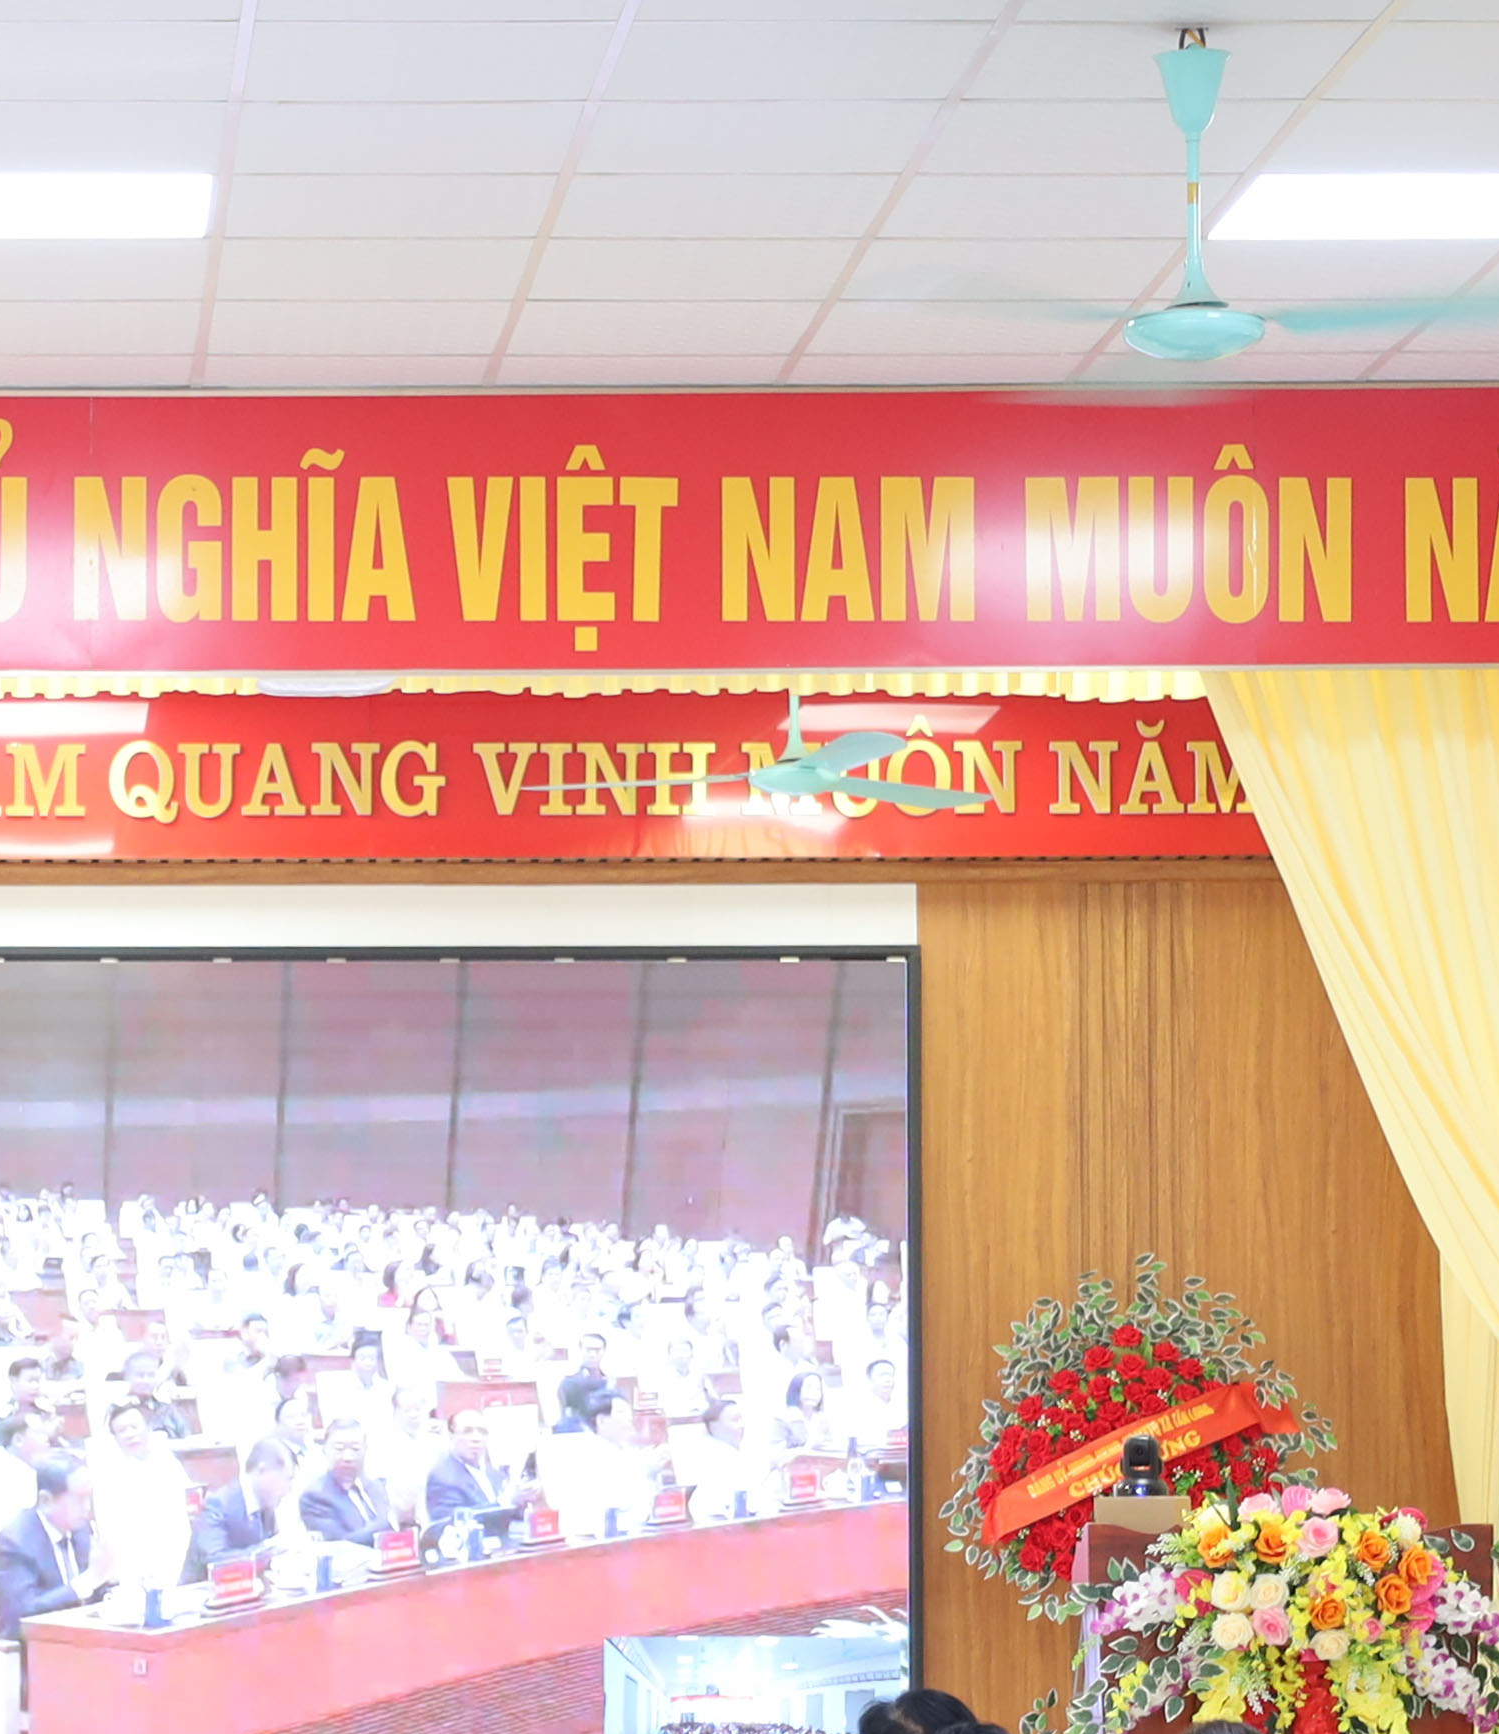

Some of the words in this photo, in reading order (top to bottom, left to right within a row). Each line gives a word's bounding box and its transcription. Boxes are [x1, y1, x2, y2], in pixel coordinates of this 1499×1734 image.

[72, 447, 417, 624] NGHĨA
[446, 443, 679, 652] VIỆT
[720, 475, 976, 622] NAM
[1024, 443, 1353, 624] MUÔN
[107, 739, 447, 825] QUANG
[472, 741, 717, 817] VINH
[1048, 718, 1257, 816] NĂM
